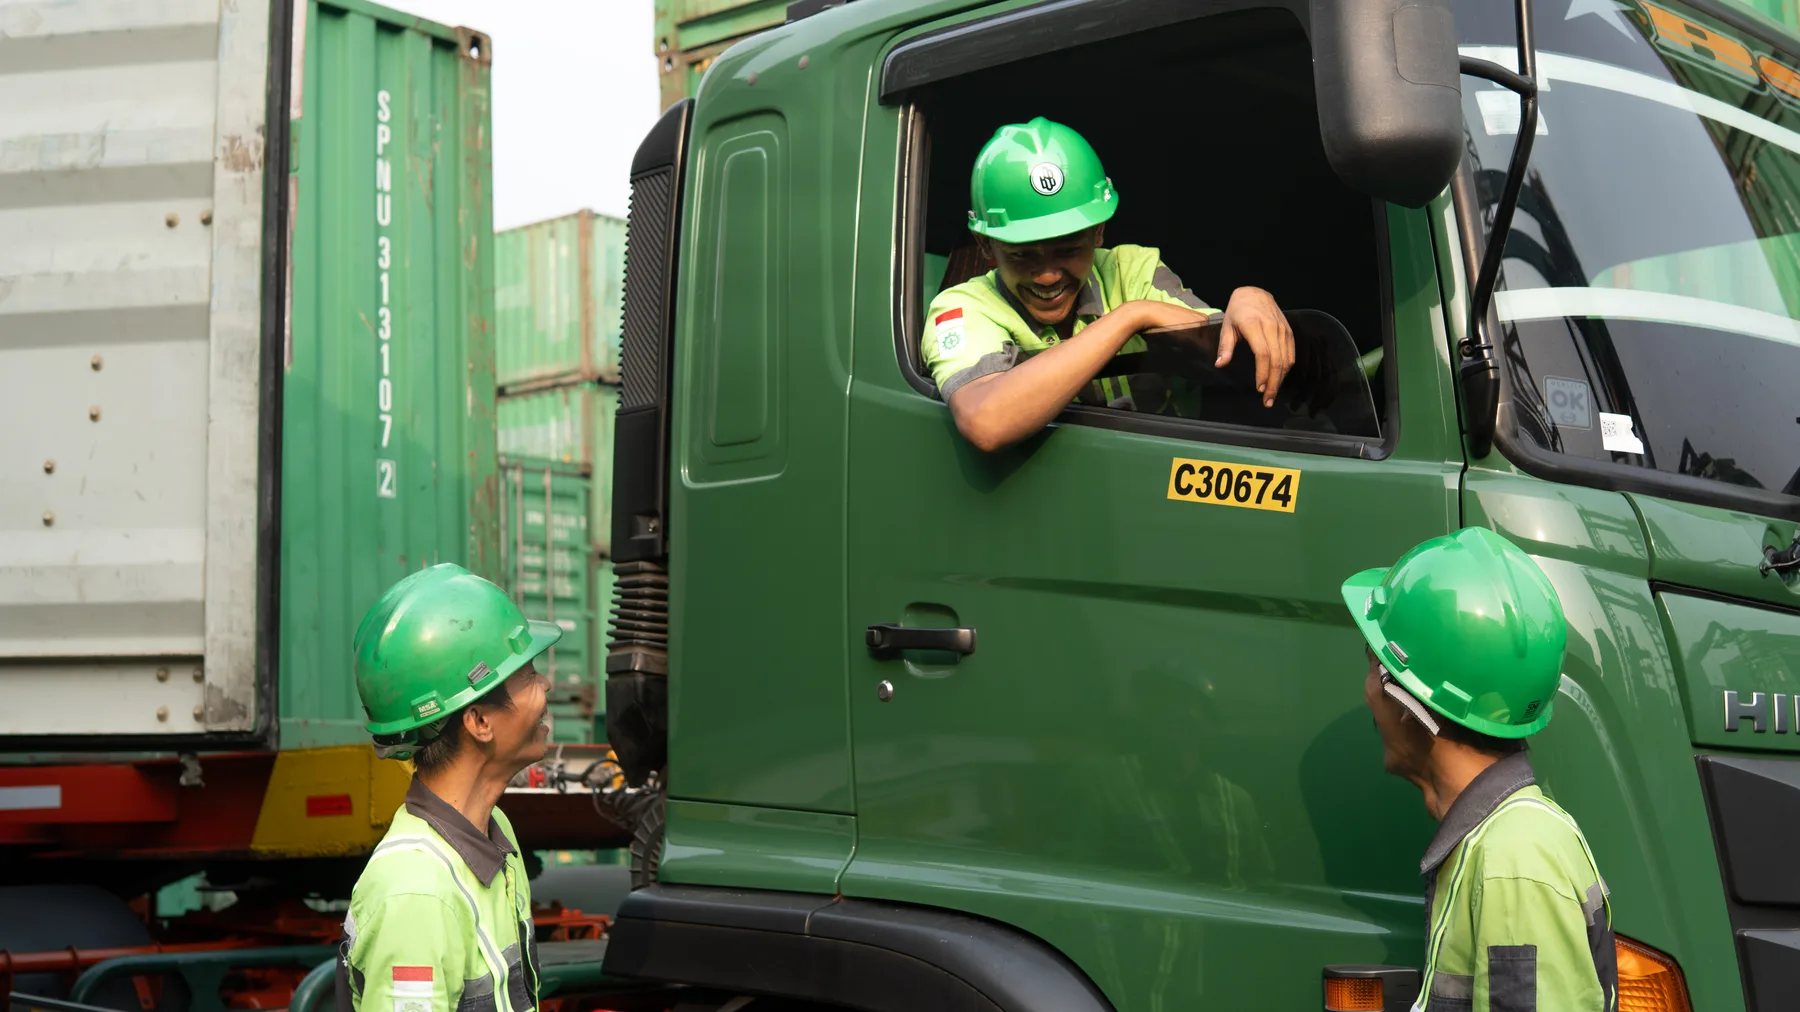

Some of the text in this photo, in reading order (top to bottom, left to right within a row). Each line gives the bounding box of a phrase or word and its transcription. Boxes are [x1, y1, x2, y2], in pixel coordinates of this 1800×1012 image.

[377, 90, 394, 497] SPNU 313107 2
[1551, 389, 1584, 412] OK
[1174, 463, 1292, 508] C30674
[1724, 690, 1800, 735] HI
